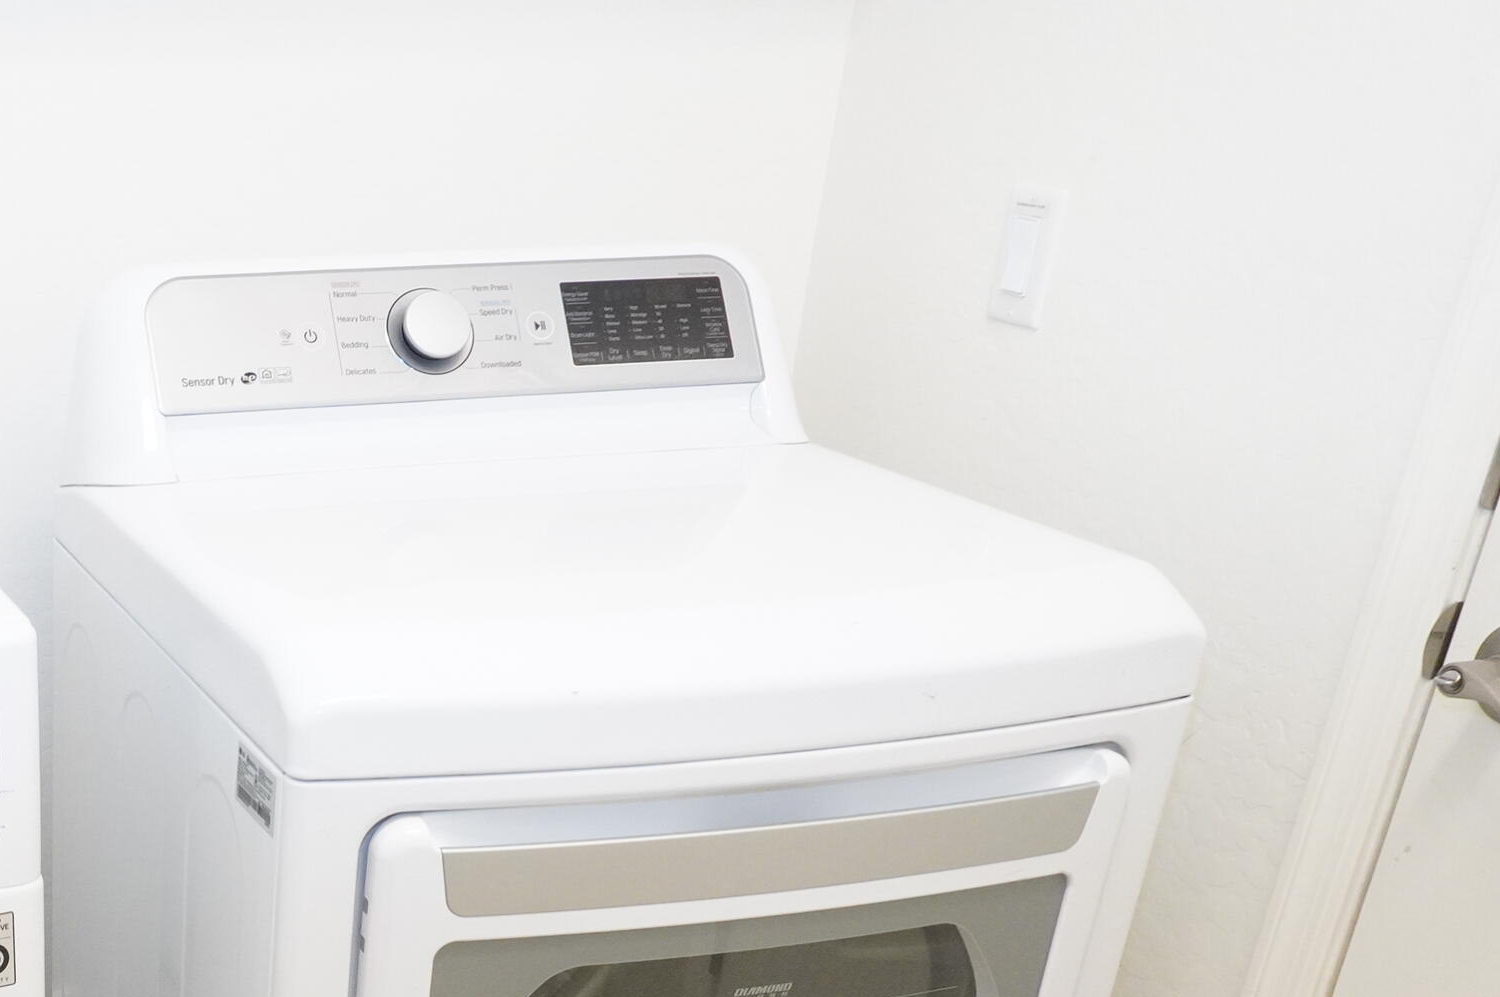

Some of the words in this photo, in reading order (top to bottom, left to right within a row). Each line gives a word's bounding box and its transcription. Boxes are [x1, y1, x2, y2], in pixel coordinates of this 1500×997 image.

[332, 290, 358, 298] Normal
[341, 341, 369, 350] Bedding
[181, 376, 215, 388] Sensor
[217, 375, 235, 388] Dry
[733, 982, 793, 997] DIAMOND
